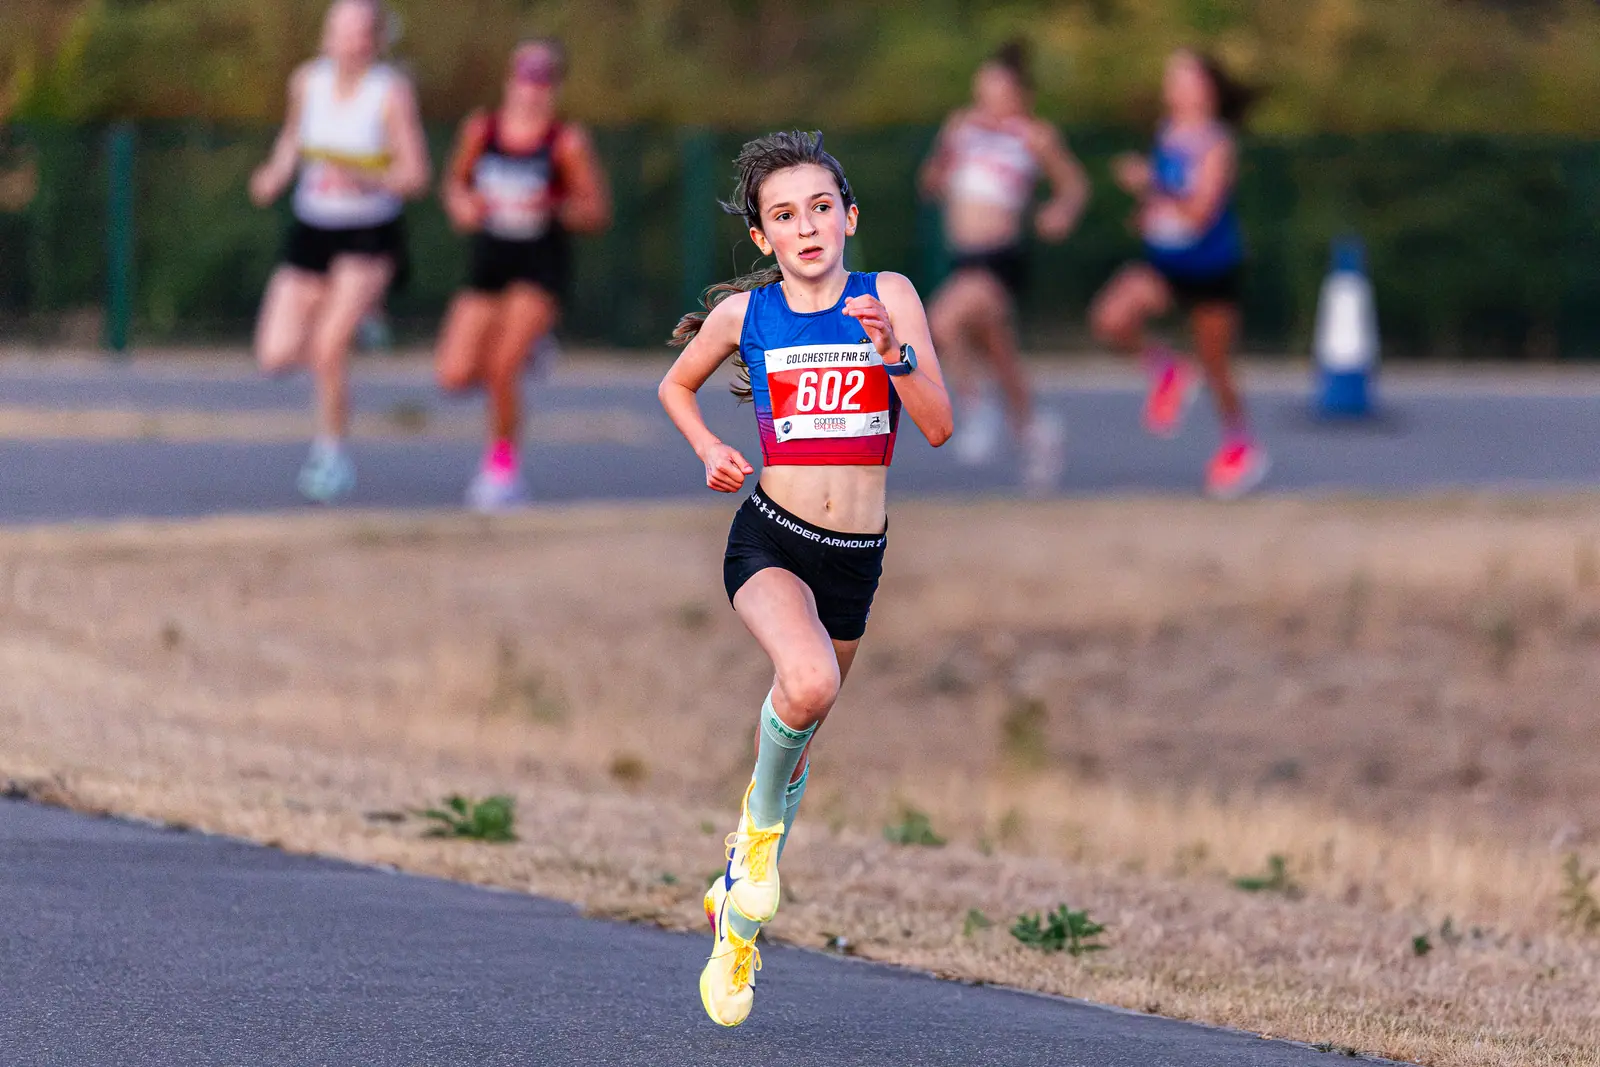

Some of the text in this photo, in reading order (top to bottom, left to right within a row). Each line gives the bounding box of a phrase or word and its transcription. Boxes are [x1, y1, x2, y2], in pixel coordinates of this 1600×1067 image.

[786, 351, 871, 365] COLCHESTER FNR 5K
[796, 370, 865, 412] 602
[813, 417, 846, 425] comms
[813, 423, 847, 432] express
[775, 515, 821, 542] UNDER
[820, 537, 875, 548] ARMOUR
